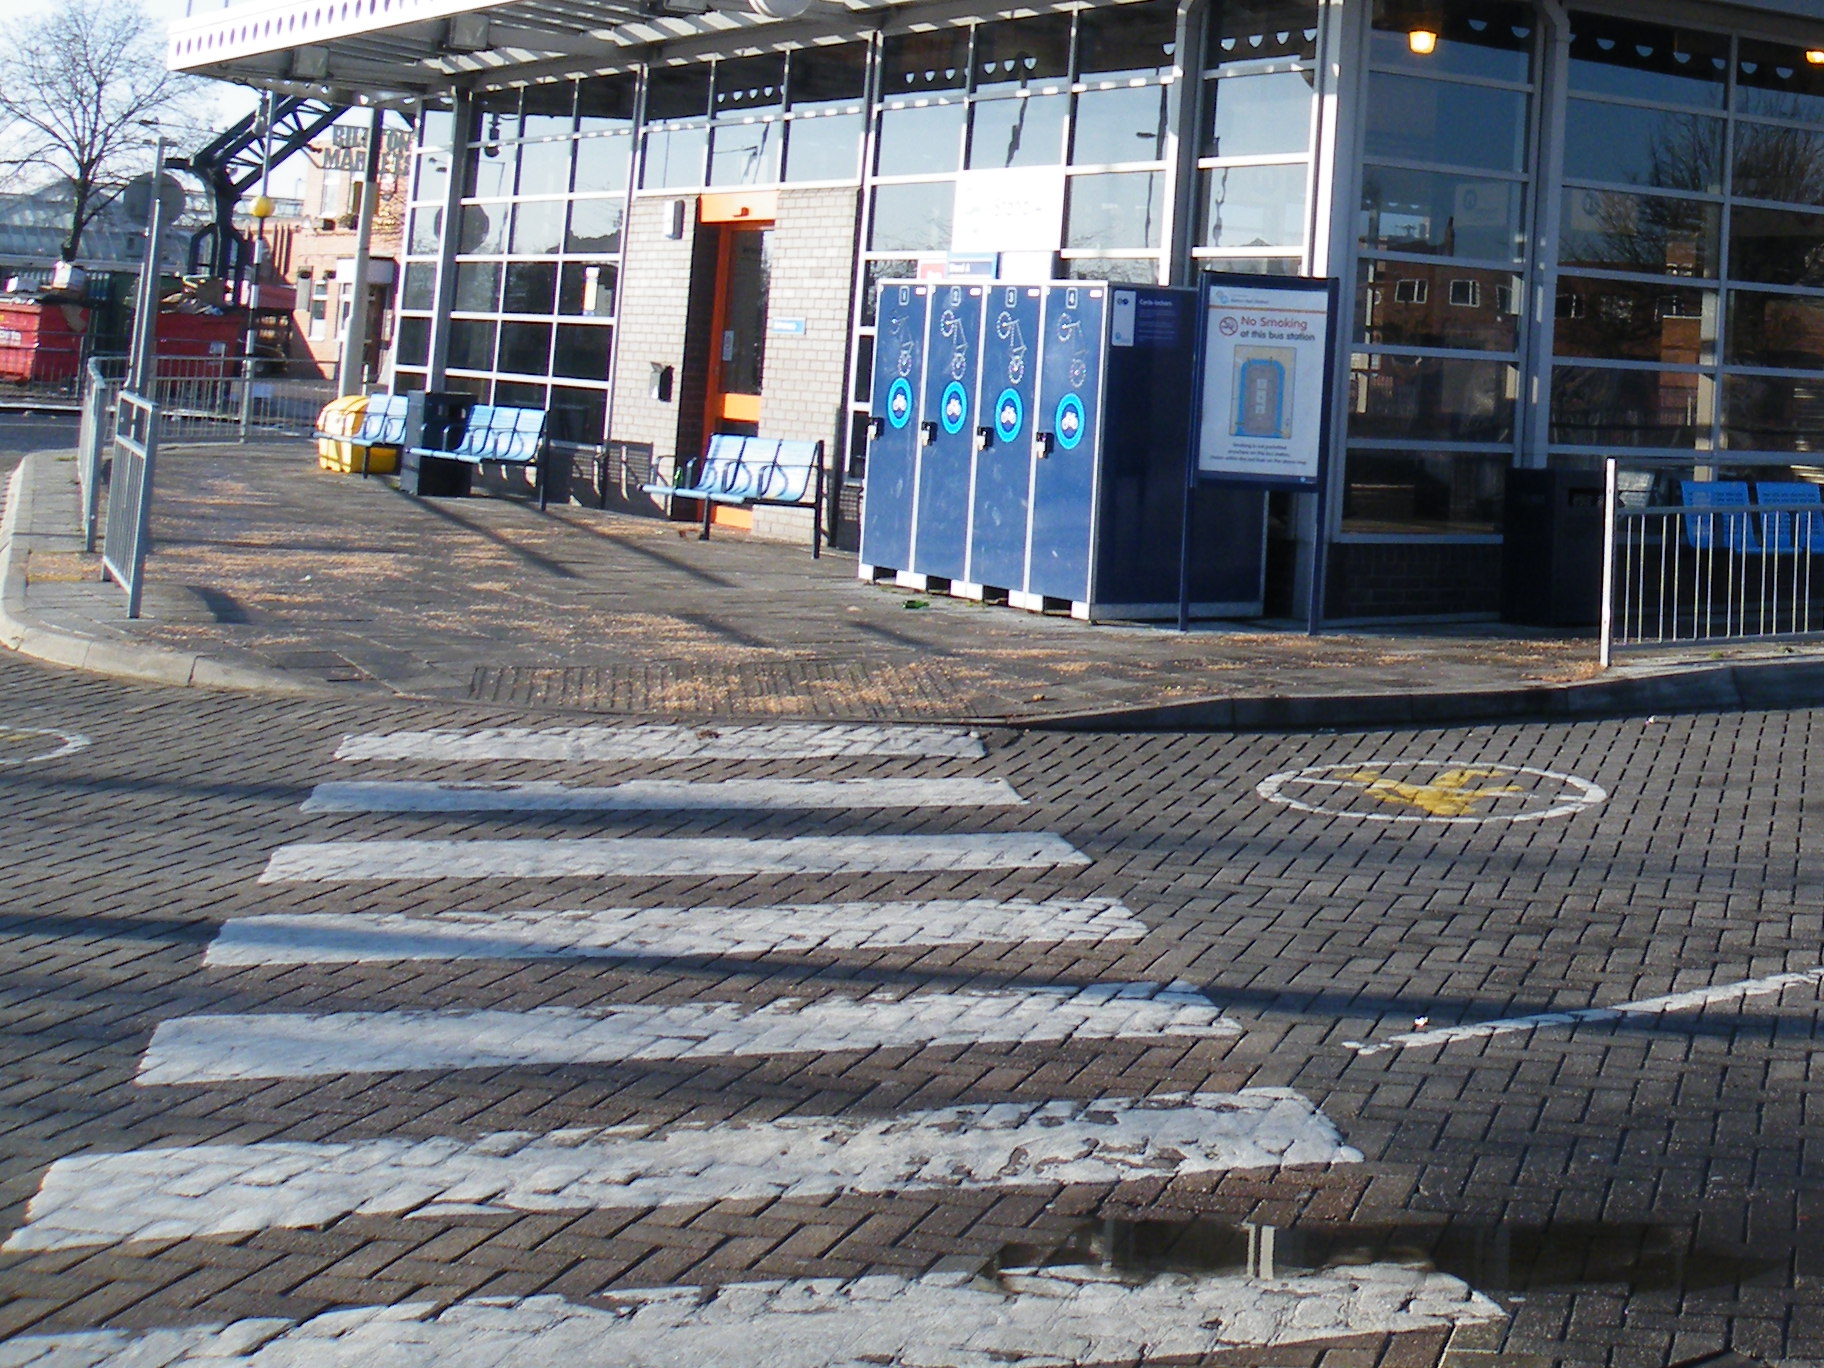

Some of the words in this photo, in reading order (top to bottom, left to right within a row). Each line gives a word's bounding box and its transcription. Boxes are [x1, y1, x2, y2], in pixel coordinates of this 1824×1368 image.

[324, 147, 412, 176] MARETS
[1241, 316, 1257, 327] No
[1260, 316, 1308, 332] Smoking
[1251, 330, 1267, 339] this
[1269, 331, 1284, 340] bus
[1286, 332, 1316, 342] station
